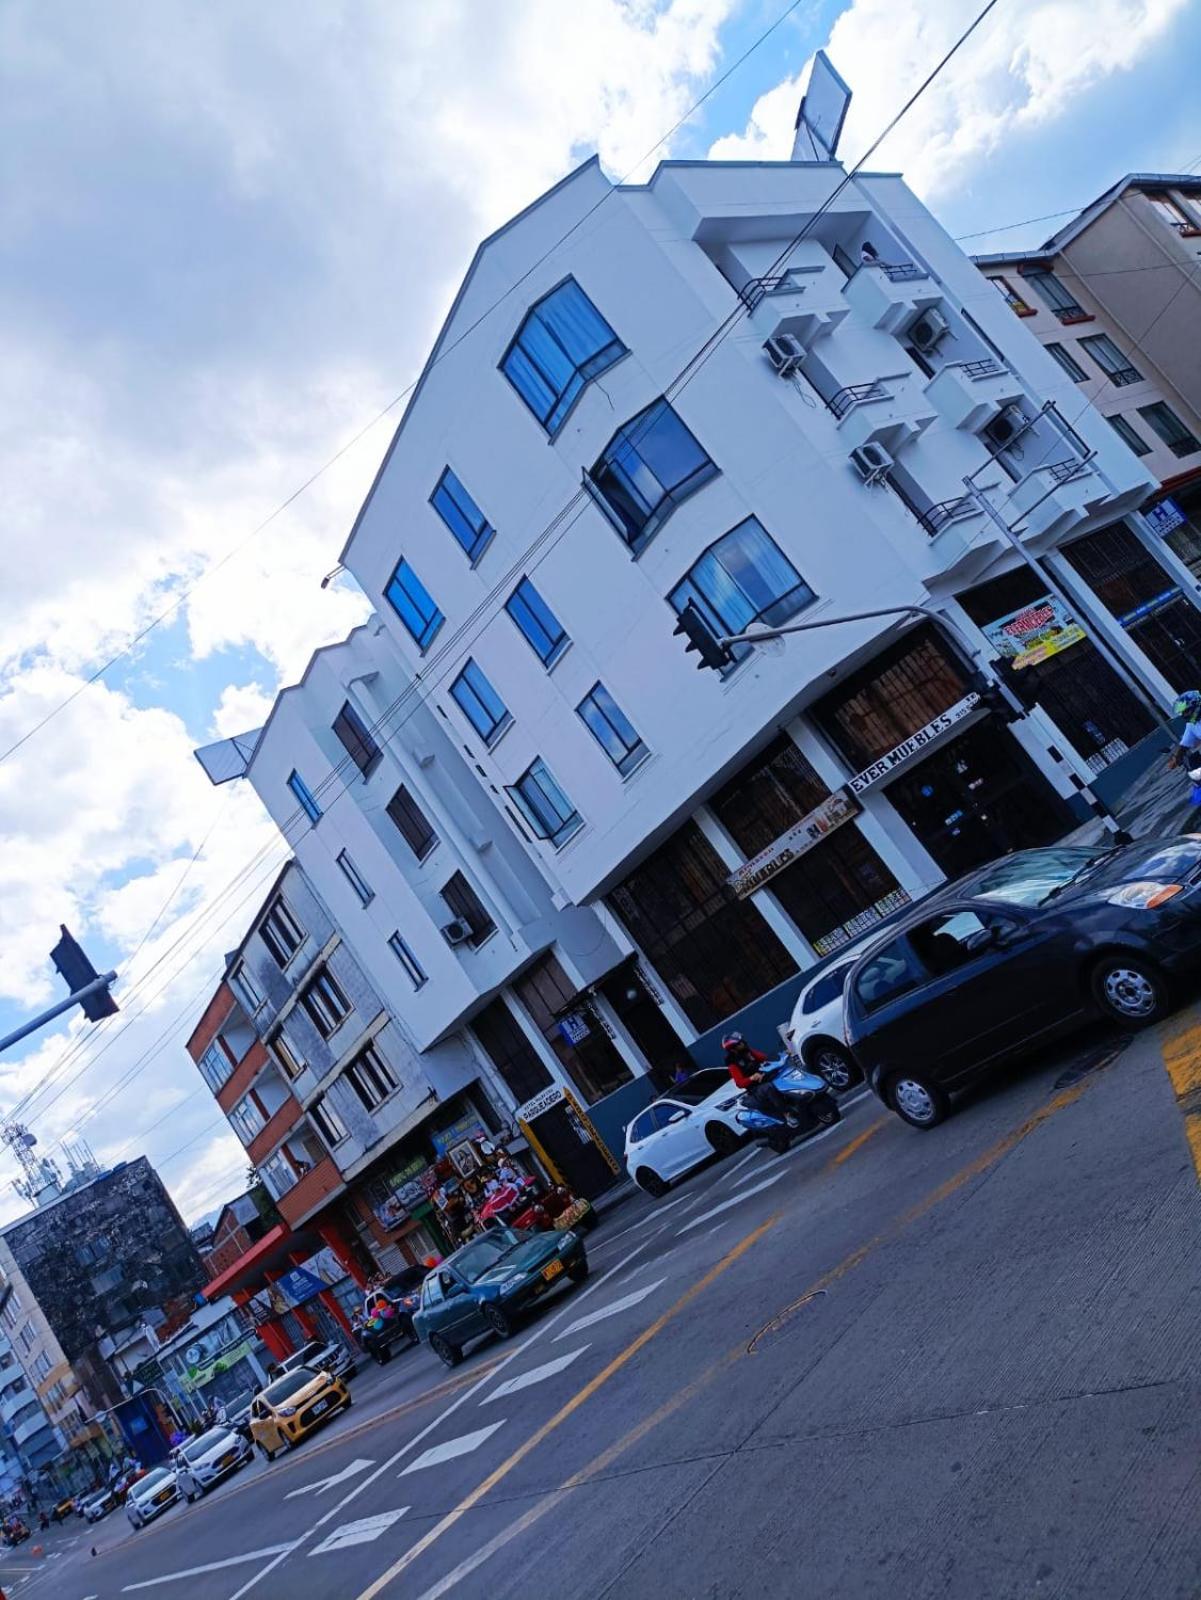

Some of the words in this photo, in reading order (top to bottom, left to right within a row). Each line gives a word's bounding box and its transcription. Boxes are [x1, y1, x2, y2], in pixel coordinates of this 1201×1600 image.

[1155, 505, 1167, 520] H
[851, 761, 890, 792] EVER
[888, 714, 952, 768] MUEBLES
[568, 1017, 579, 1029] H
[522, 1090, 562, 1120] PARQUEADERO
